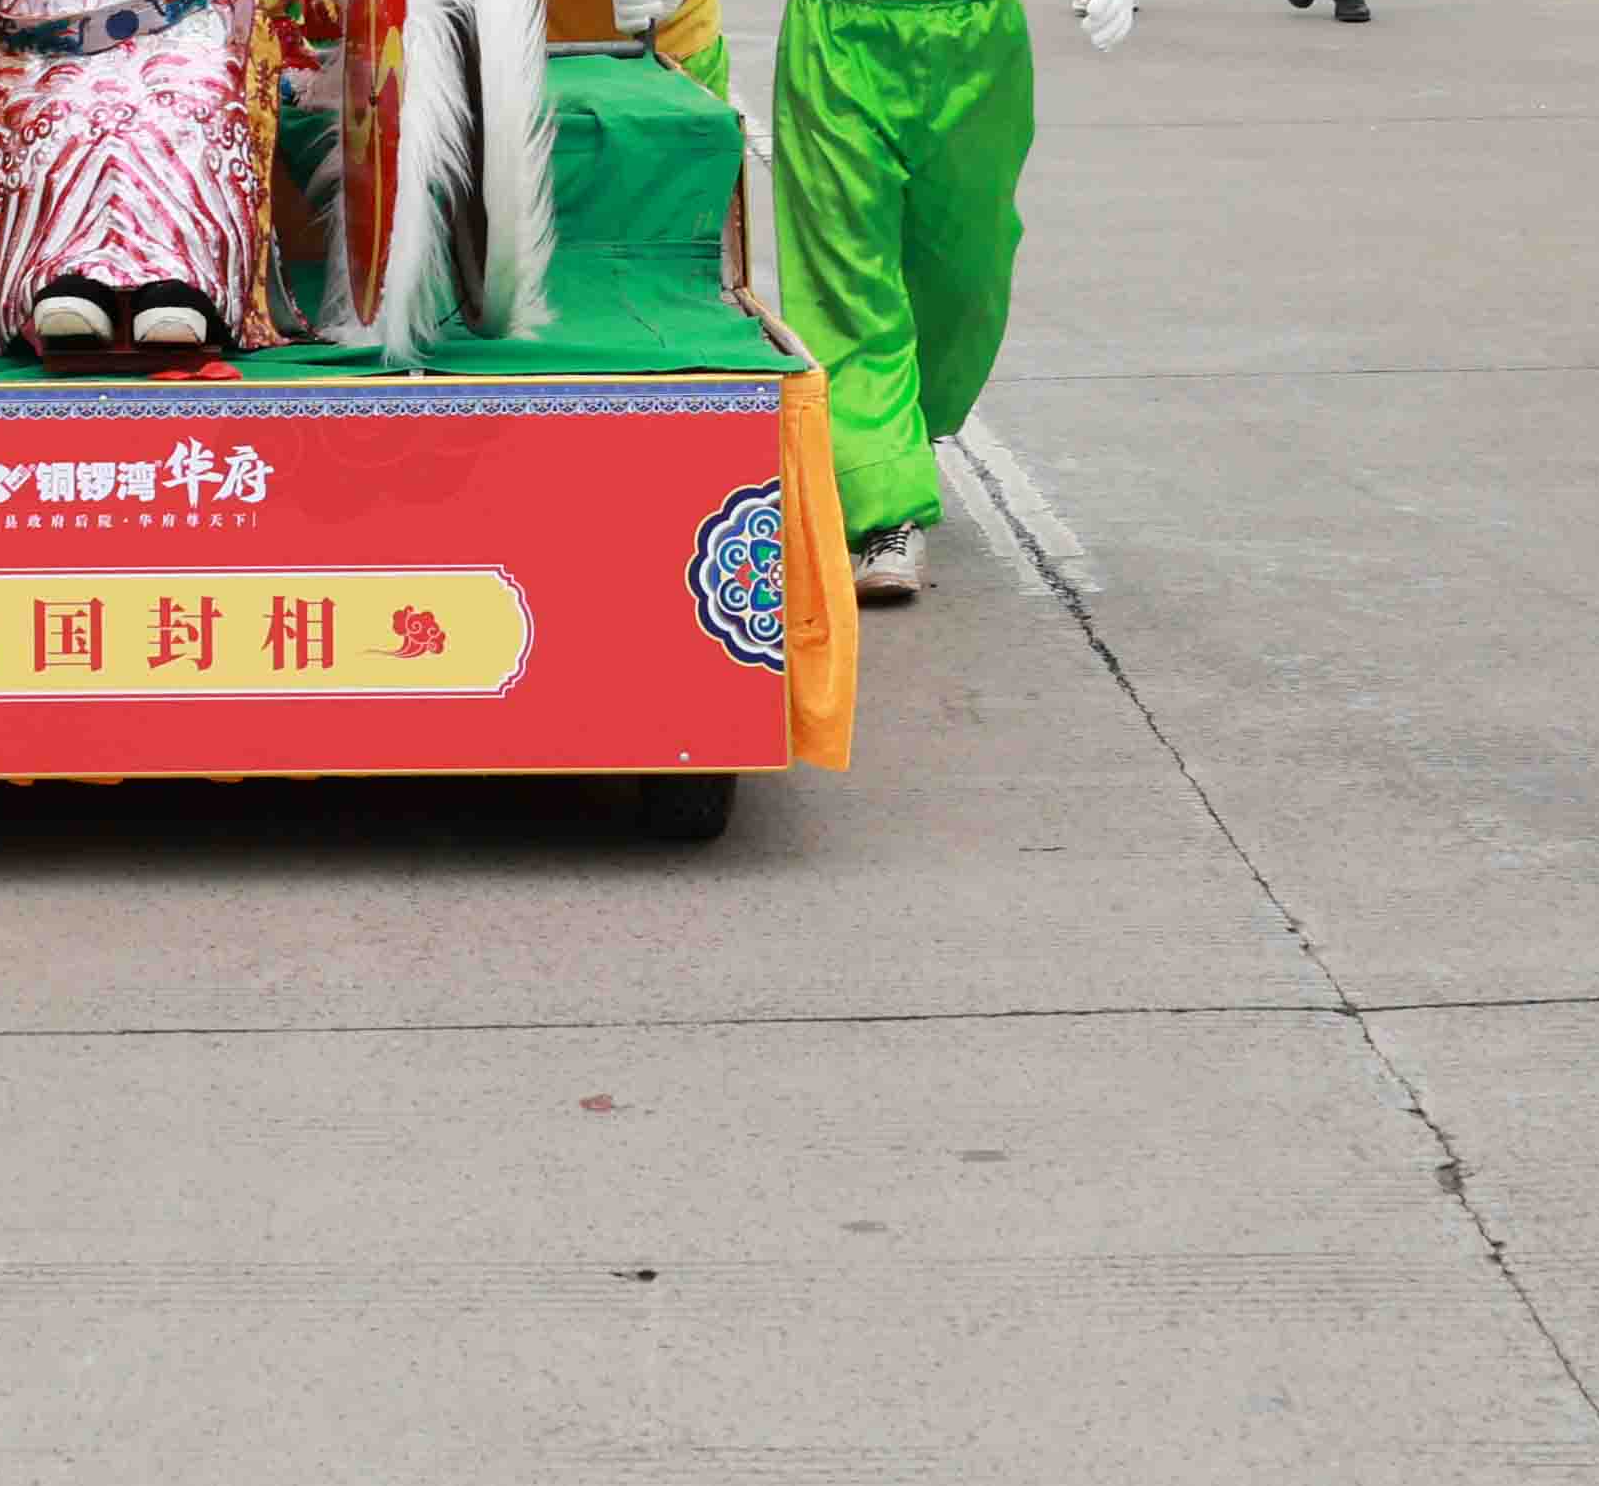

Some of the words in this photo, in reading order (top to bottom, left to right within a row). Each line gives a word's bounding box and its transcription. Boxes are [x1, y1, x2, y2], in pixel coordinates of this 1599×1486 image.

[35, 435, 274, 507] 铜锣湾华府
